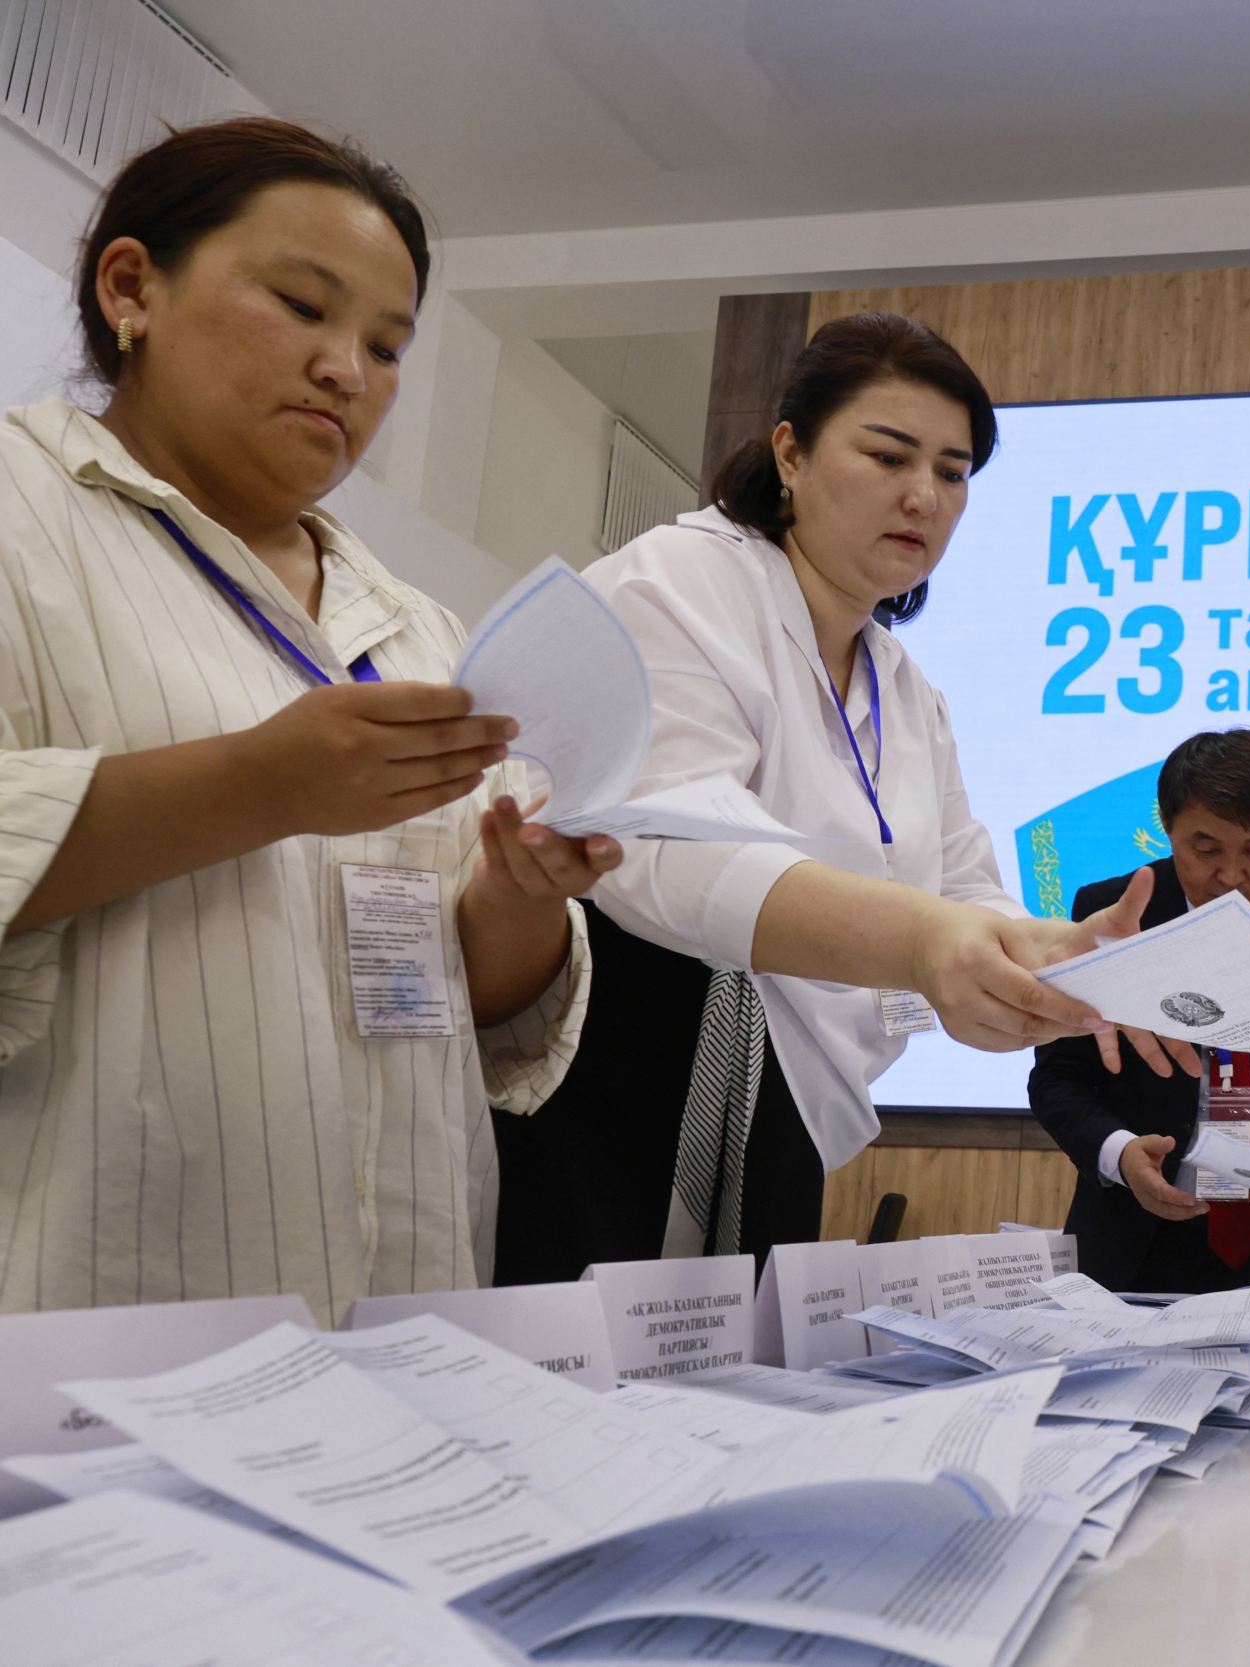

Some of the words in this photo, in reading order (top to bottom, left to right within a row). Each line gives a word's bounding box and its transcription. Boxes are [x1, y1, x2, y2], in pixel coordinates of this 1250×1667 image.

[1041, 604, 1187, 715] 23
[985, 1275, 1042, 1289] ОБЩЕНАЦИОНАЛНАЯ
[646, 1300, 673, 1316] ЖОЛ»
[645, 1315, 726, 1338] ДЕМОКРАТИЯЛЫҚ
[658, 1336, 709, 1356] ПАРТИЯСЫ
[533, 1354, 585, 1374] ТИЯСЫ
[711, 1351, 743, 1368] ПАРТИЯ
